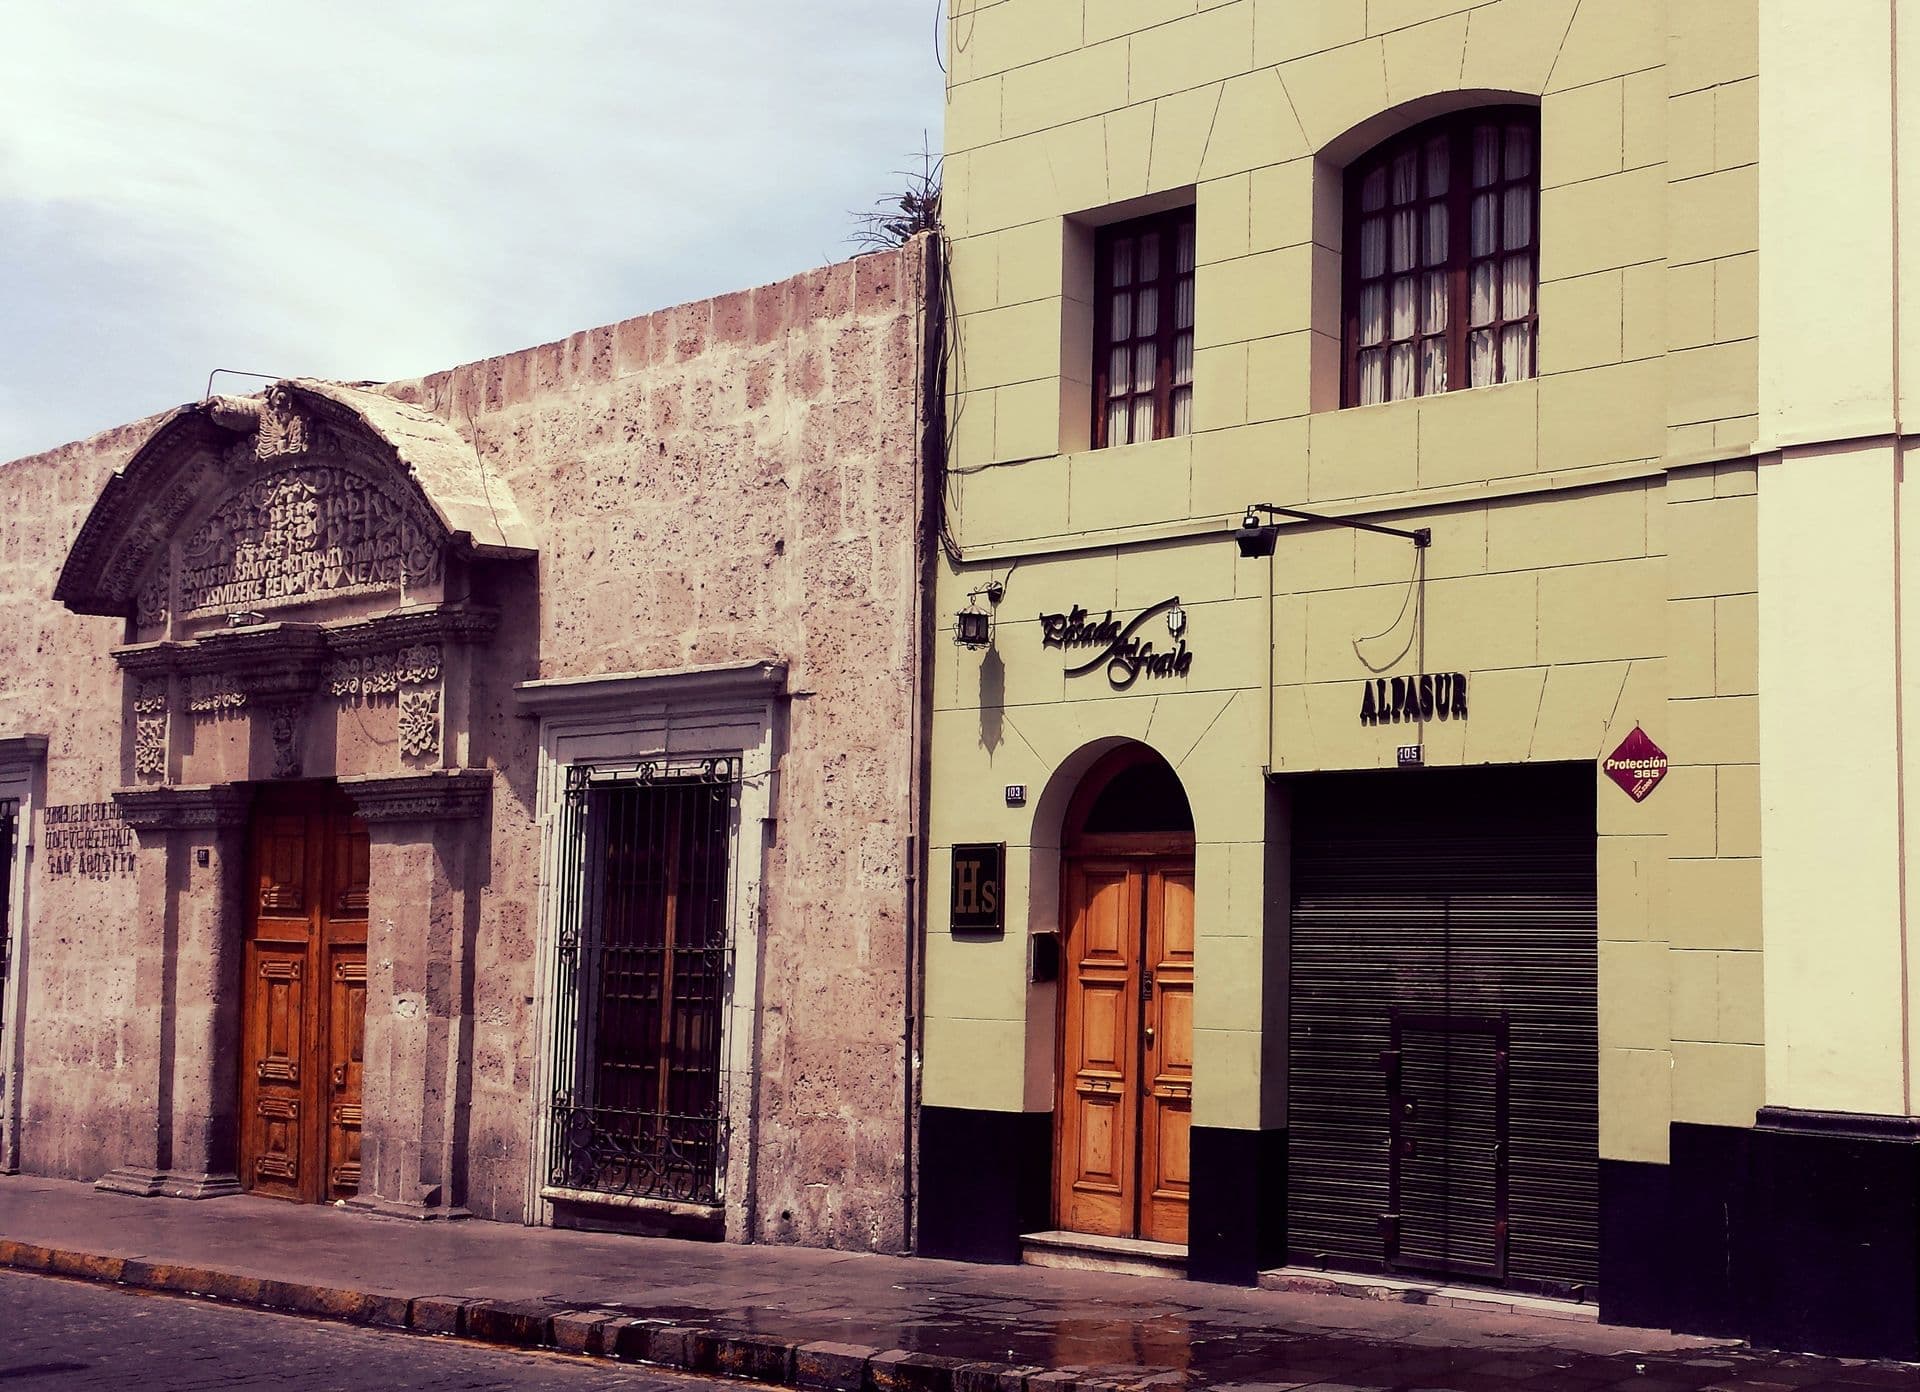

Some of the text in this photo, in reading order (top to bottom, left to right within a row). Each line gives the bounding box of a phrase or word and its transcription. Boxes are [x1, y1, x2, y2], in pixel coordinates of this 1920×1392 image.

[1040, 609, 1121, 650] Posada
[1108, 639, 1193, 691] Fraile
[1360, 672, 1468, 727] ALPASUR
[1399, 747, 1417, 759] 105
[1606, 756, 1667, 770] Protección
[1634, 769, 1660, 778] 365
[1007, 786, 1021, 797] 103
[955, 861, 996, 913] Hs
